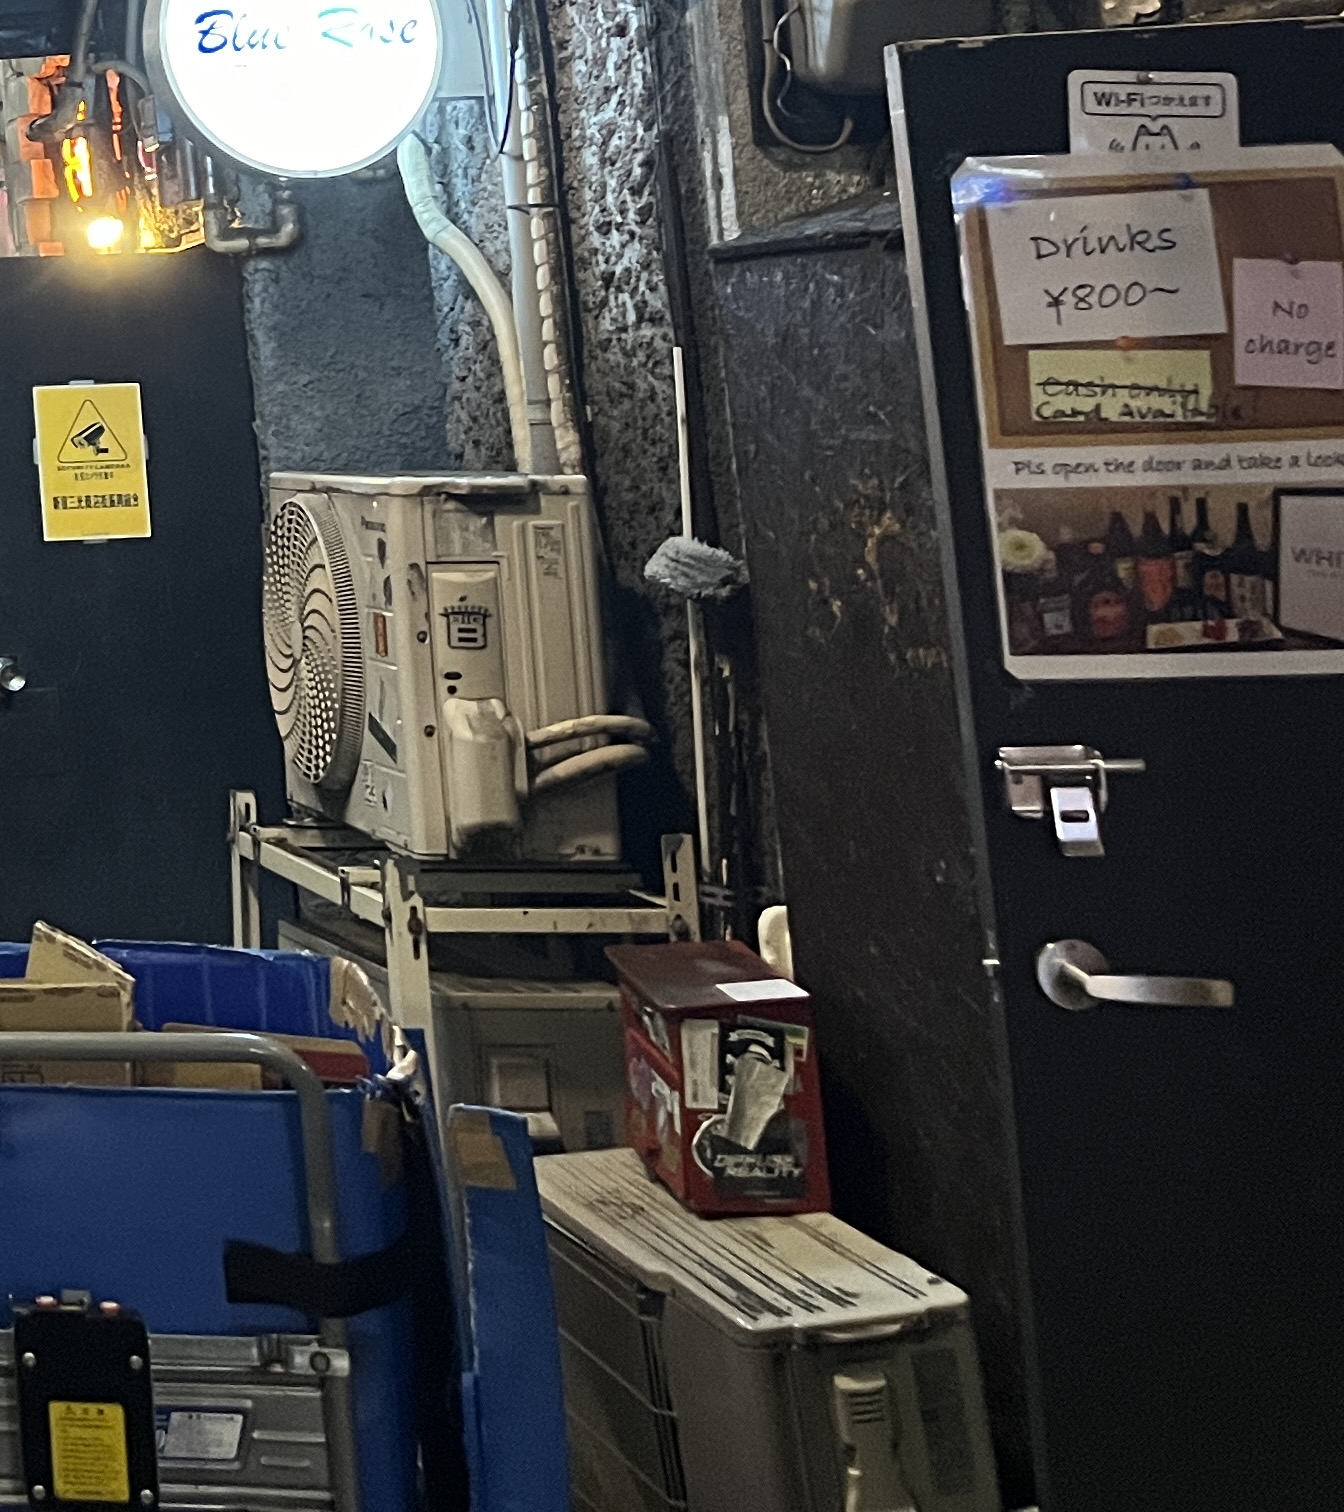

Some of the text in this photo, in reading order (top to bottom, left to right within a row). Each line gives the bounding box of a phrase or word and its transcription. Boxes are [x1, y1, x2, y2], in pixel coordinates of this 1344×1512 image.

[195, 9, 291, 54] Blue
[1029, 224, 1177, 260] Drinks
[1272, 300, 1310, 319] No
[1244, 335, 1336, 364] charge
[1052, 461, 1099, 480] open
[1104, 456, 1134, 473] the
[1141, 455, 1182, 472] door
[1191, 454, 1232, 471] and
[1237, 454, 1282, 470] take
[1289, 455, 1300, 468] a
[1291, 546, 1344, 569] WHI
